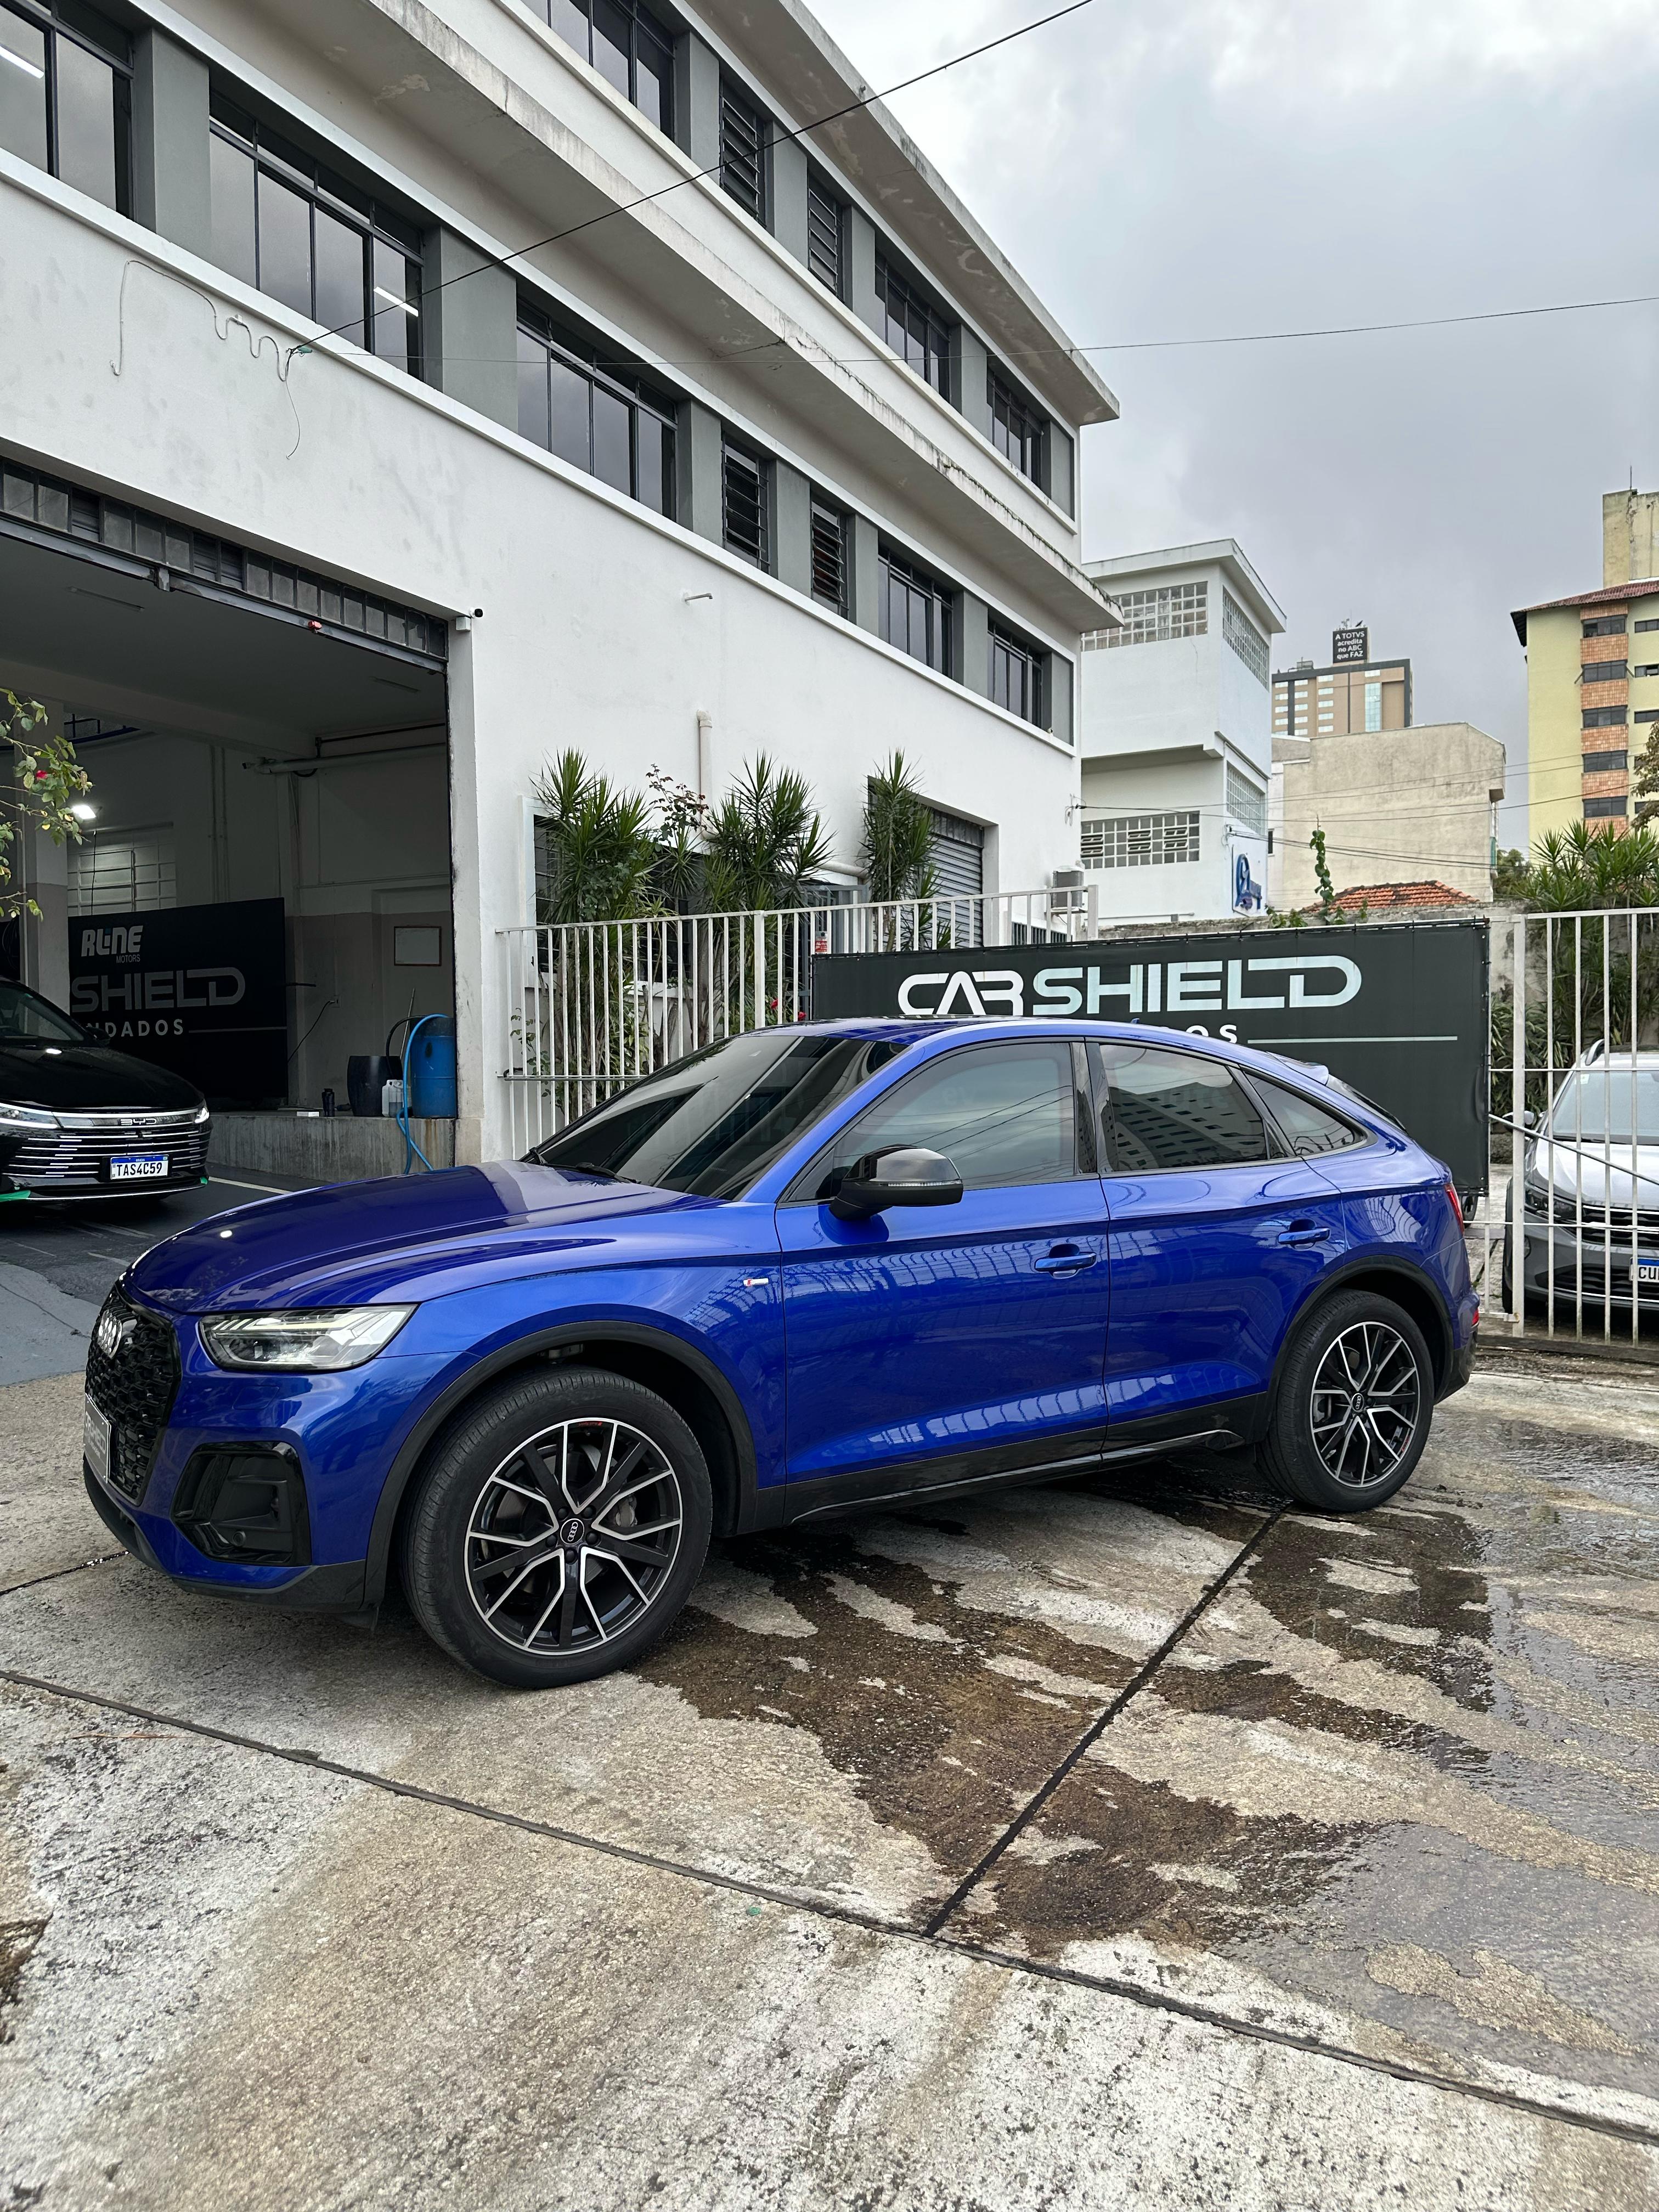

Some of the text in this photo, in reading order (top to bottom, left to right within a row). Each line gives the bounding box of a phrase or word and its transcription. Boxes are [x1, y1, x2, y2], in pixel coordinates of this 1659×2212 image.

[1341, 631, 1365, 639] TOTVS
[116, 953, 140, 964] MOTORS
[71, 967, 245, 1013] SHIELD
[116, 1162, 162, 1176] TAS4C59
[1639, 1267, 1659, 1280] CU
